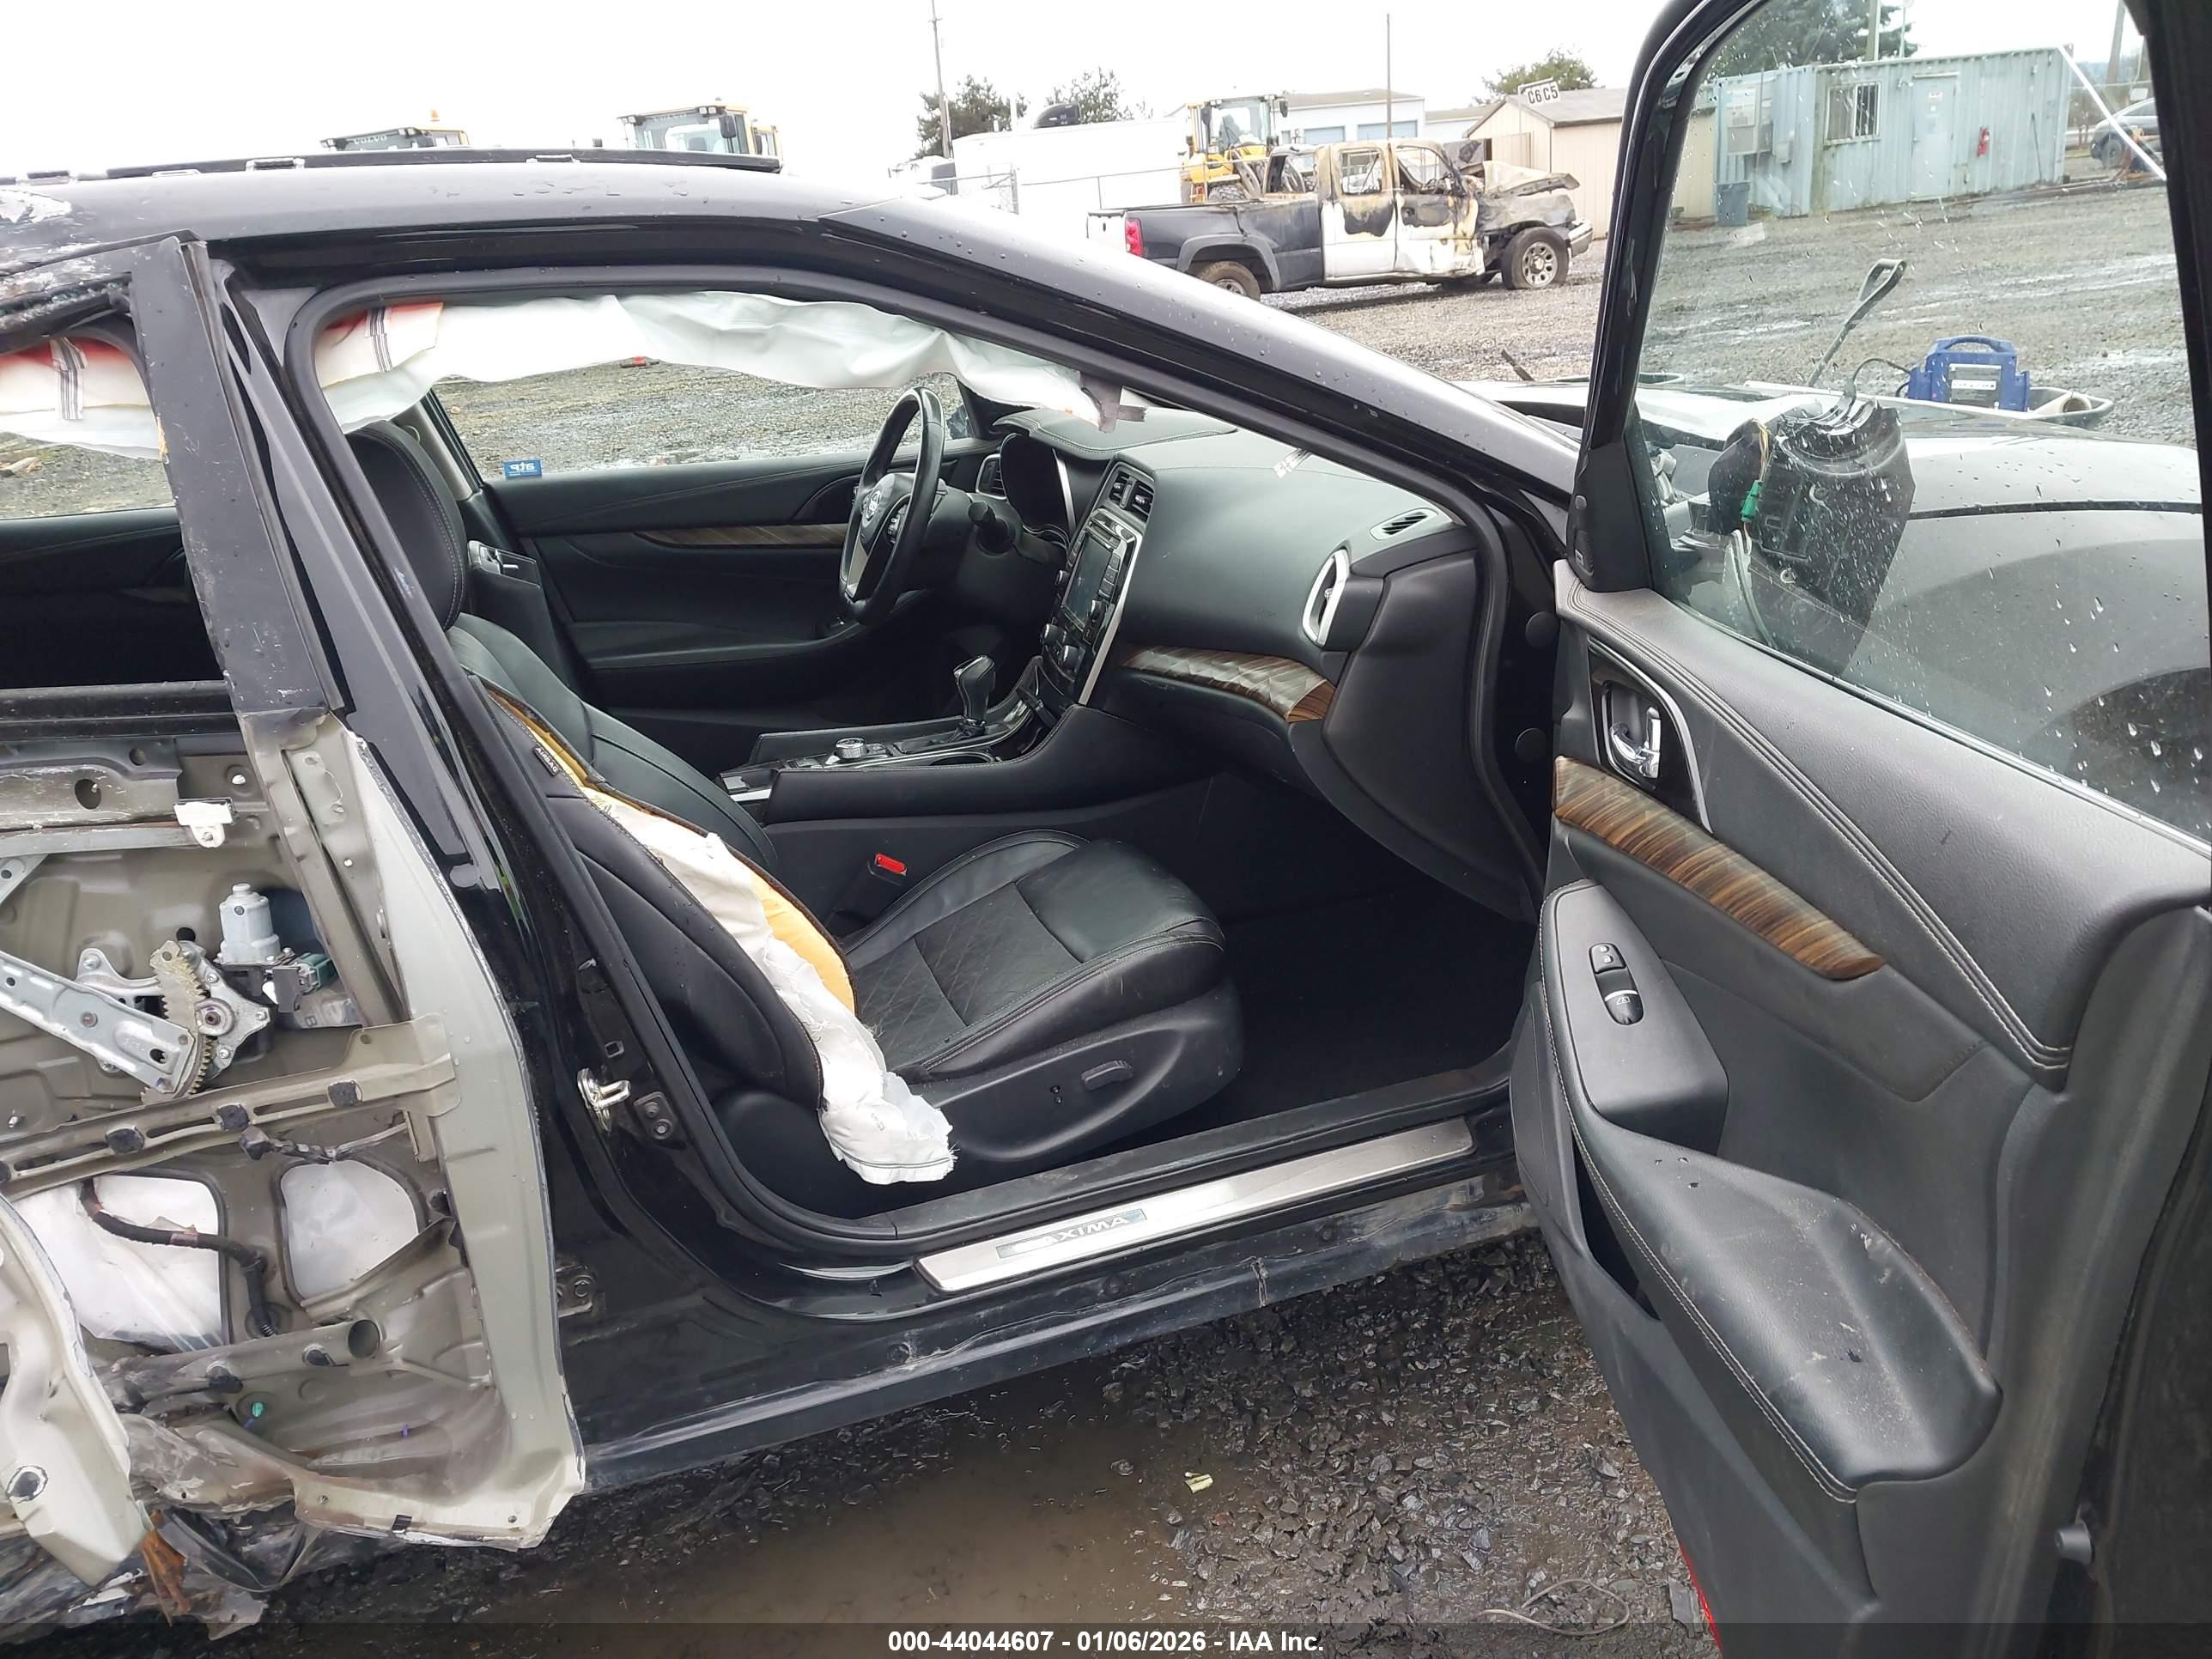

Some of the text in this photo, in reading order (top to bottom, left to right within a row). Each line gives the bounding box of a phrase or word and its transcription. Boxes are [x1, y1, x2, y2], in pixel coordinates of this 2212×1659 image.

[353, 134, 387, 145] VOLVO
[535, 747, 559, 772] AIRBAG
[1035, 1216, 1130, 1244] AXIMA
